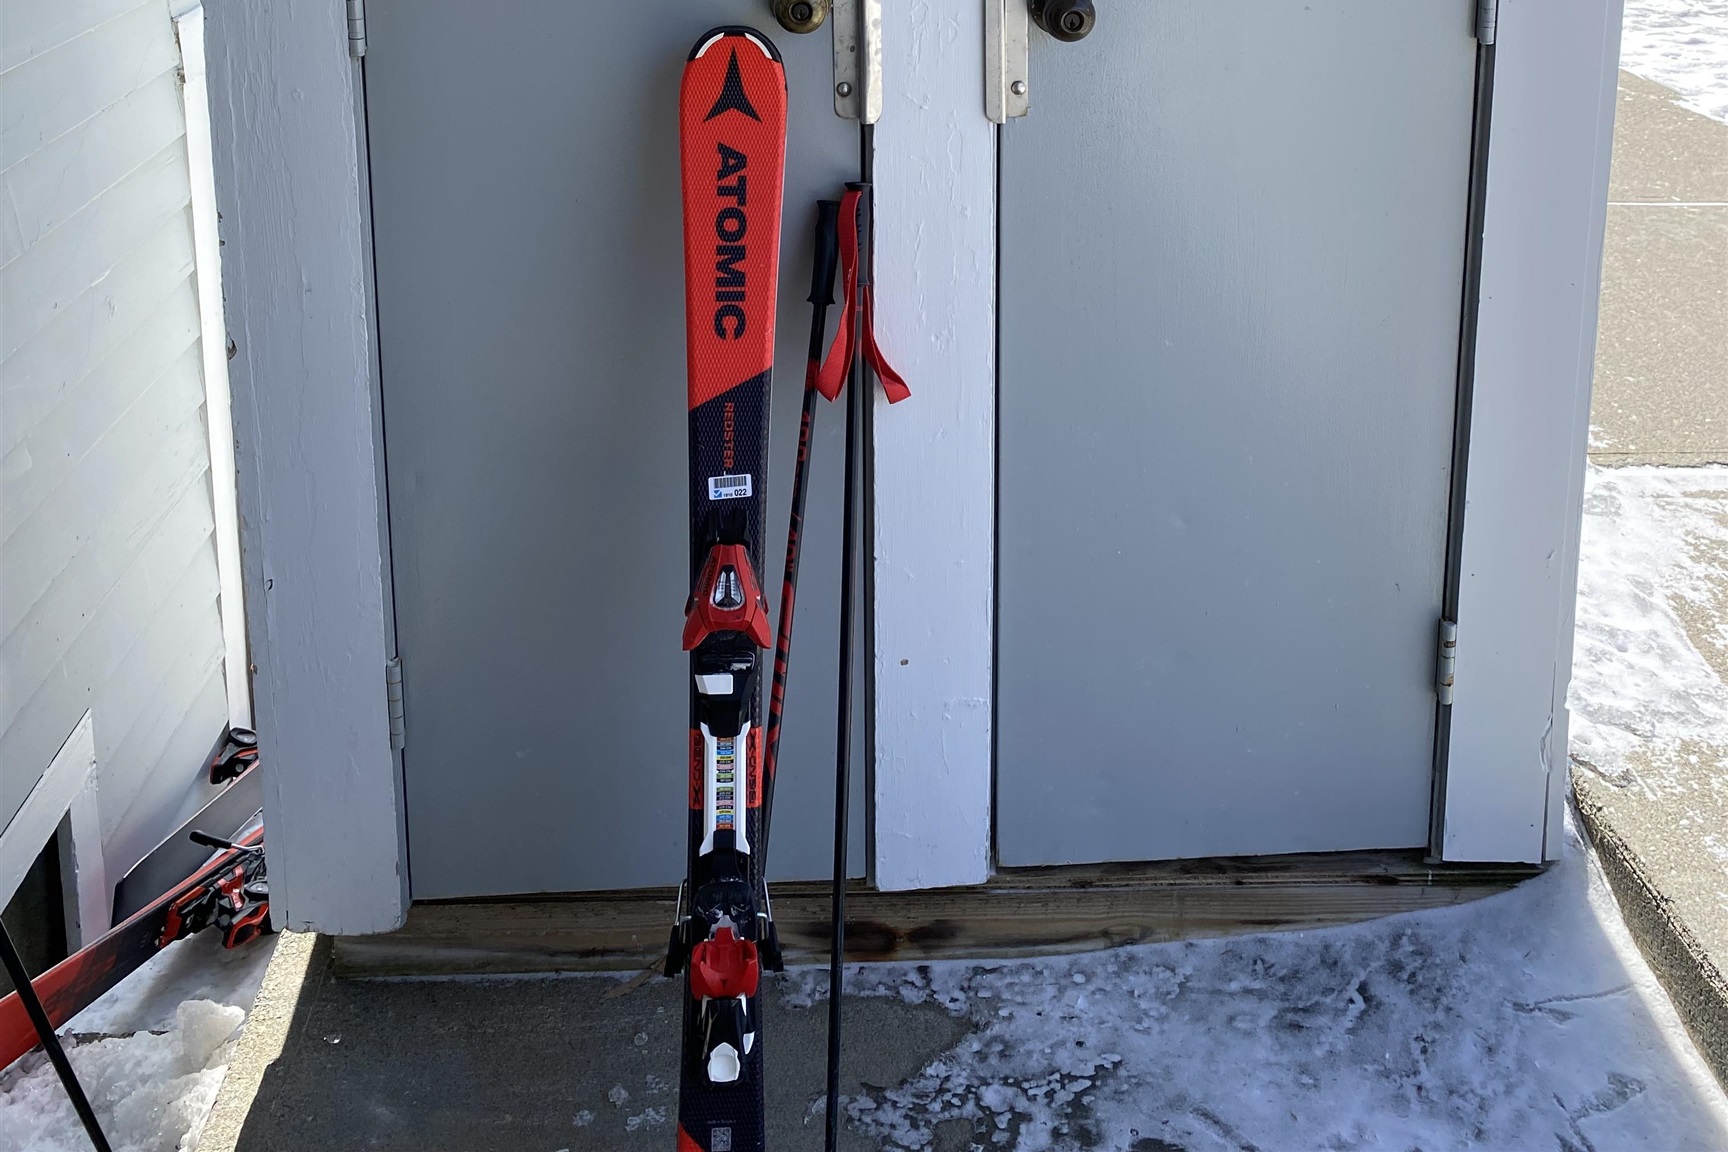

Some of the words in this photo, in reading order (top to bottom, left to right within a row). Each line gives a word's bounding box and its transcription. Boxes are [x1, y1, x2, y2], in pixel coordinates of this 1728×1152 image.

[714, 141, 748, 340] ATOMIC
[723, 401, 735, 469] REDSTER
[734, 488, 747, 497] 022
